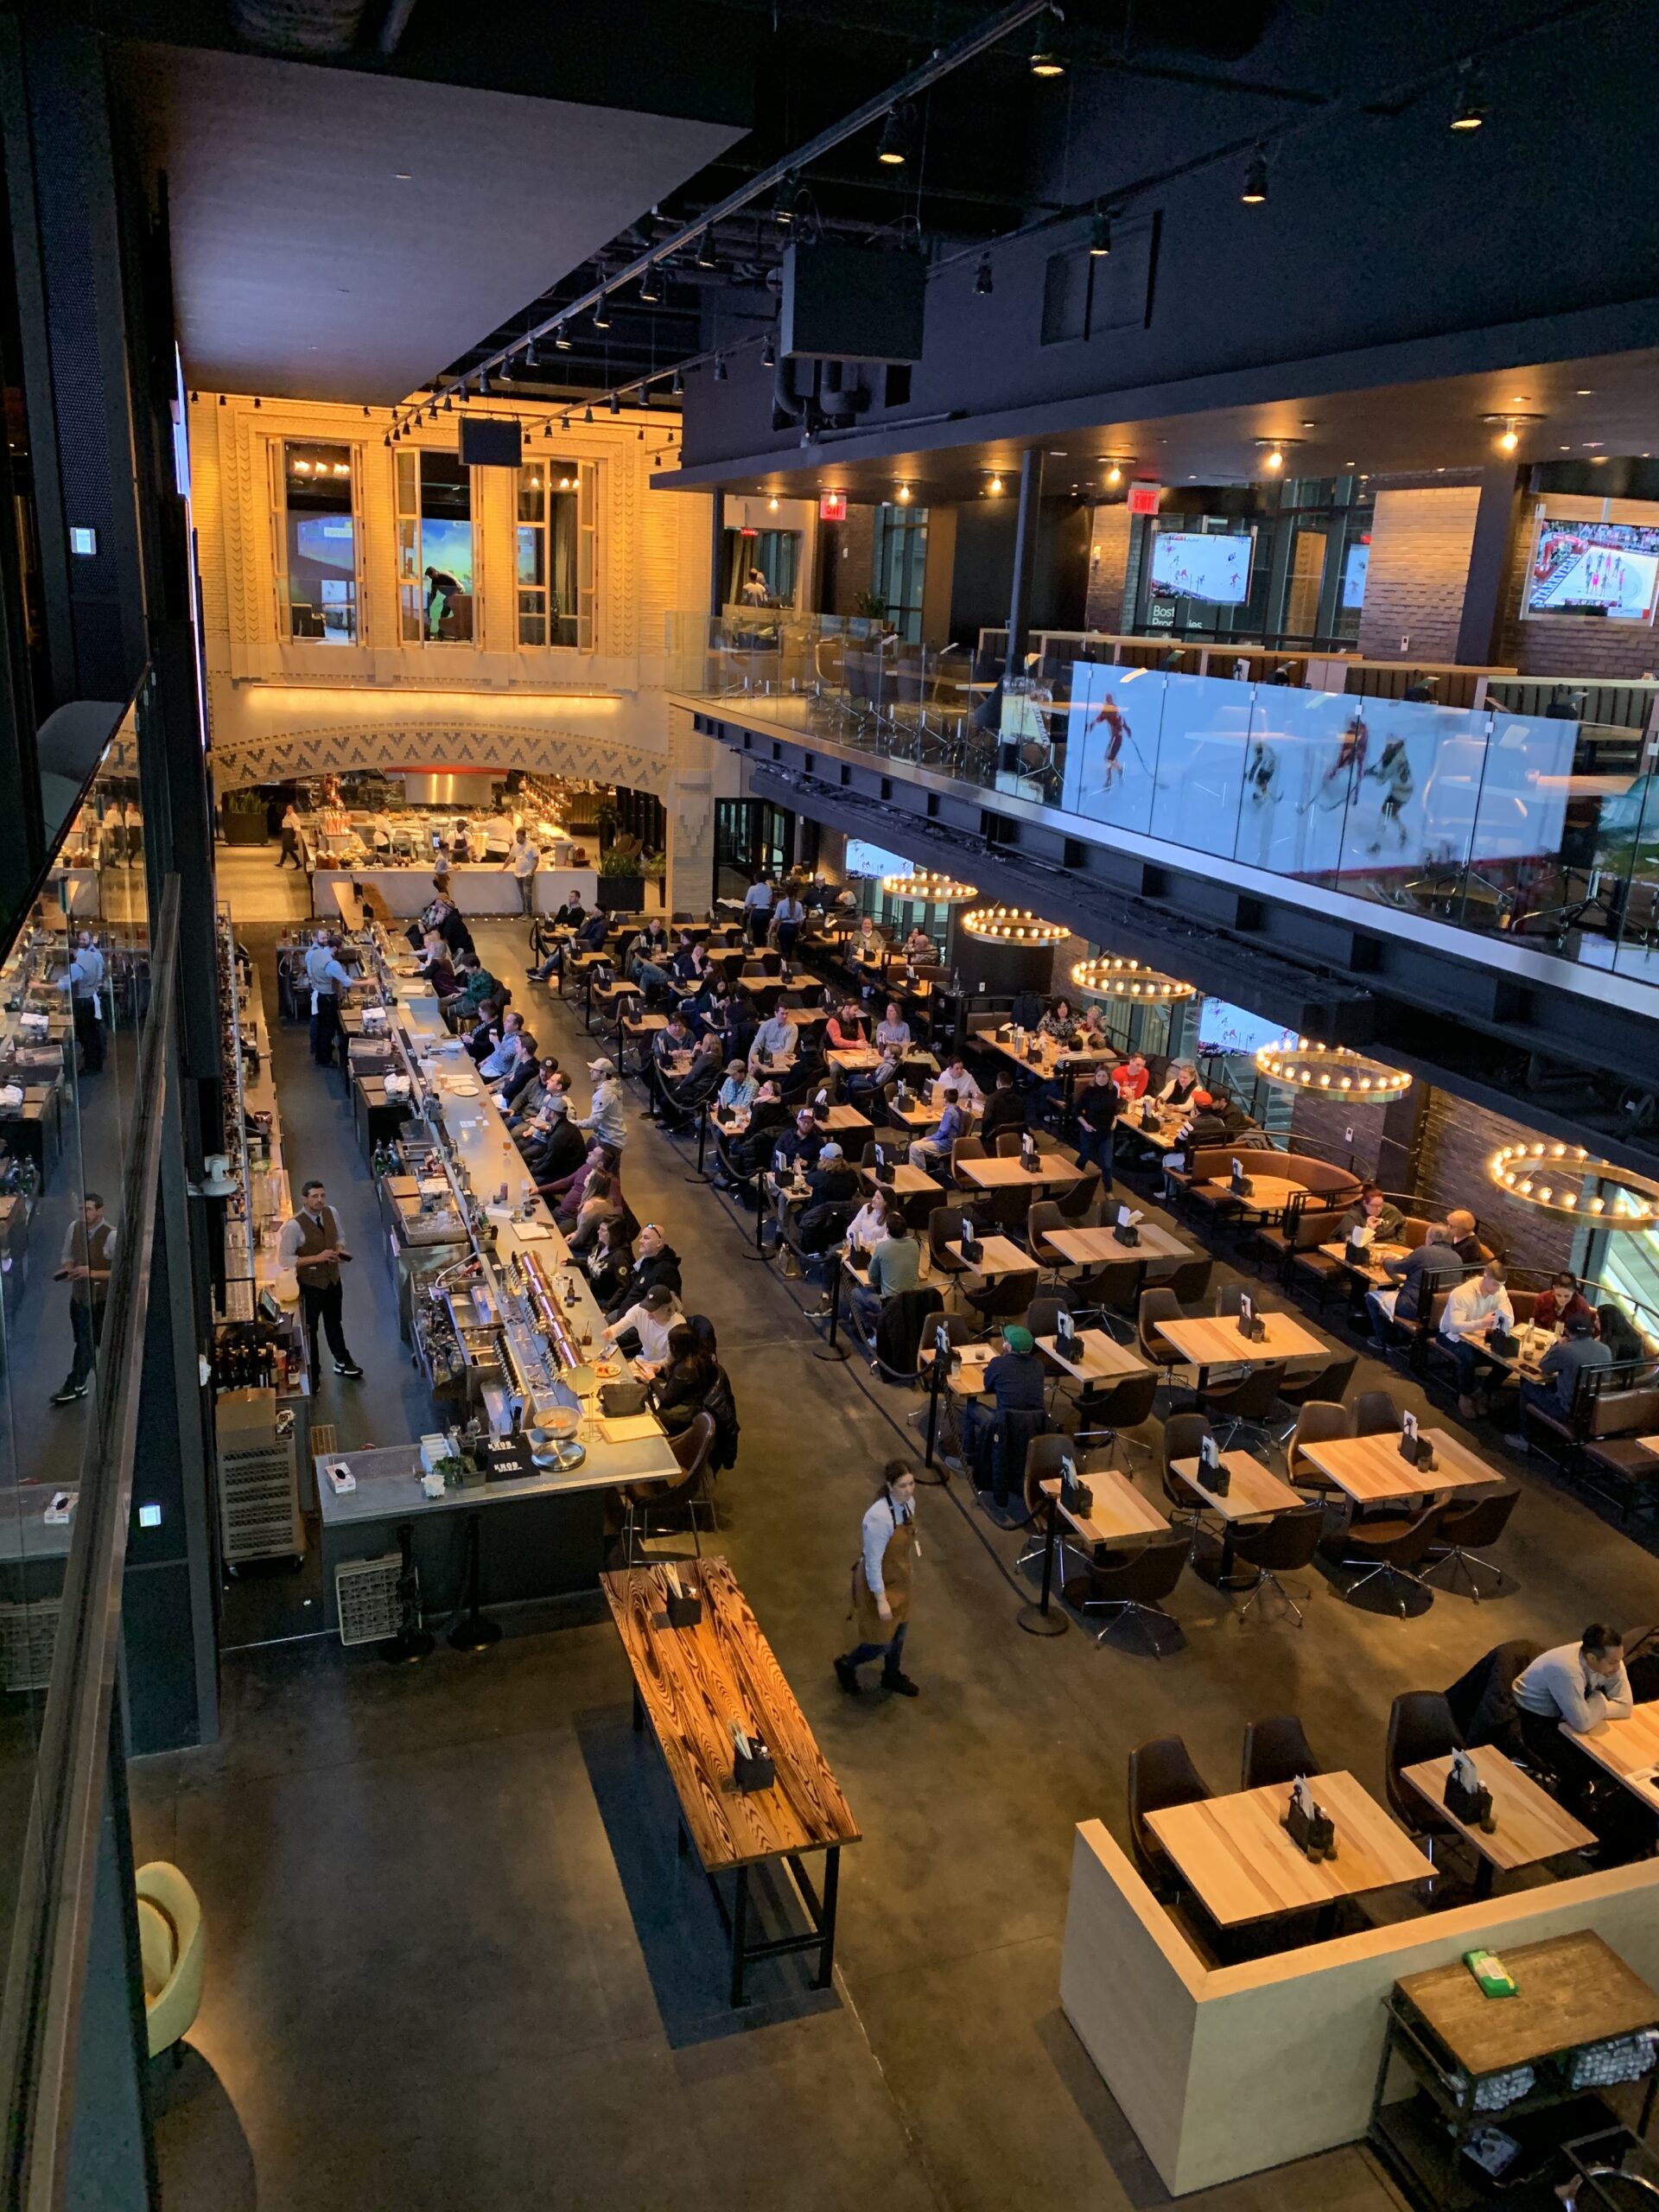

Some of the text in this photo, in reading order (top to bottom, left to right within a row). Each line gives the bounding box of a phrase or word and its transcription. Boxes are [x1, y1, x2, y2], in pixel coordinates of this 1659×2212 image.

[1530, 554, 1582, 607] STARKVEGAS
[1153, 605, 1175, 618] Bost
[493, 1461, 518, 1471] KNOB
